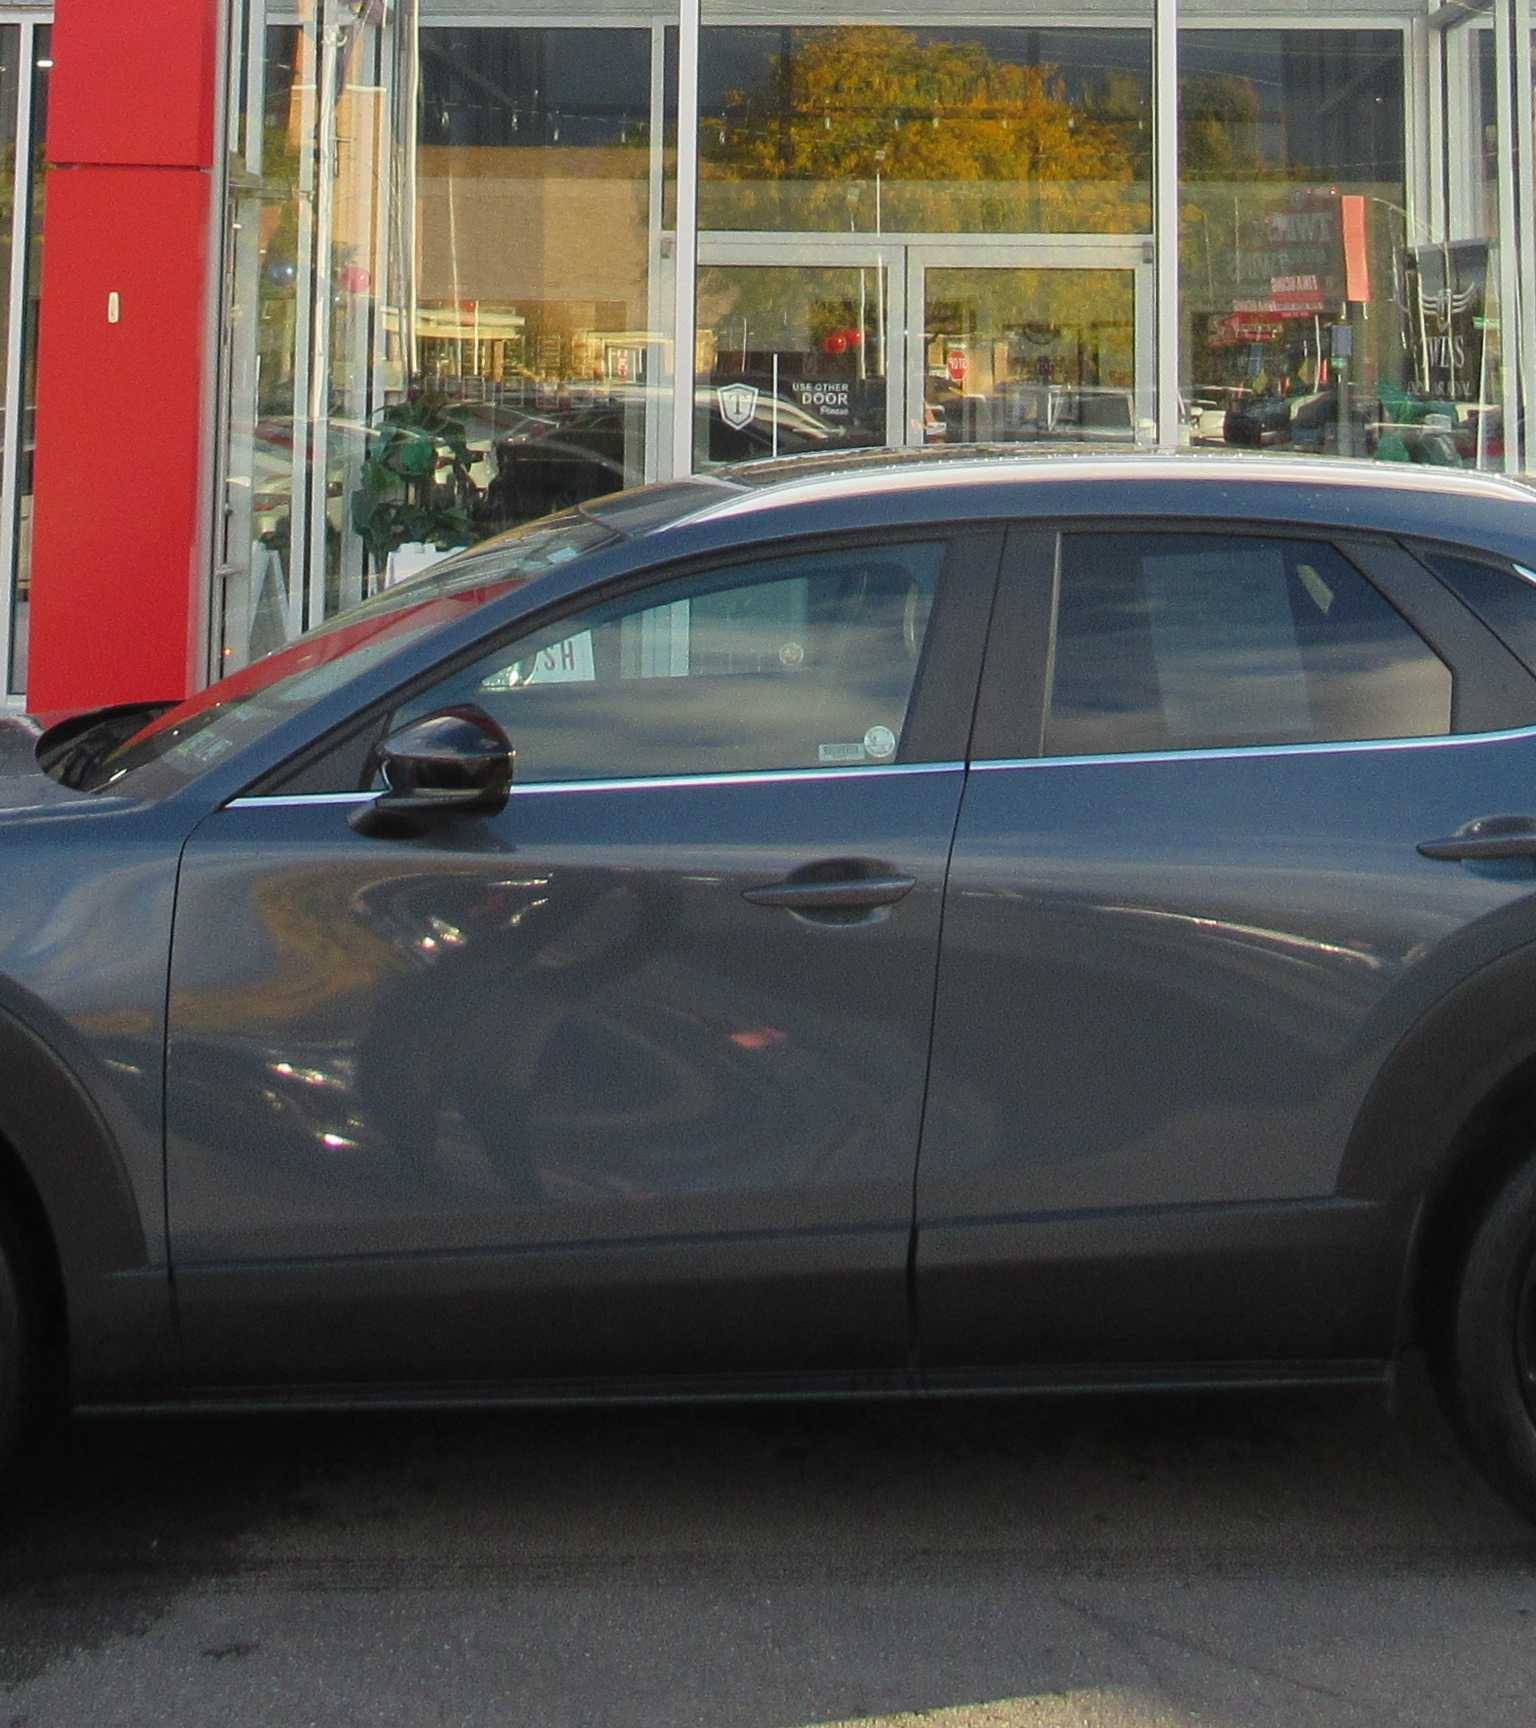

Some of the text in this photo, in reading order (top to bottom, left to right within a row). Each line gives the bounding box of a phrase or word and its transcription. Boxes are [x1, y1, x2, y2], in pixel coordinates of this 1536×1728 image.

[792, 383, 849, 392] USE OTHER
[802, 392, 849, 405] DOOR
